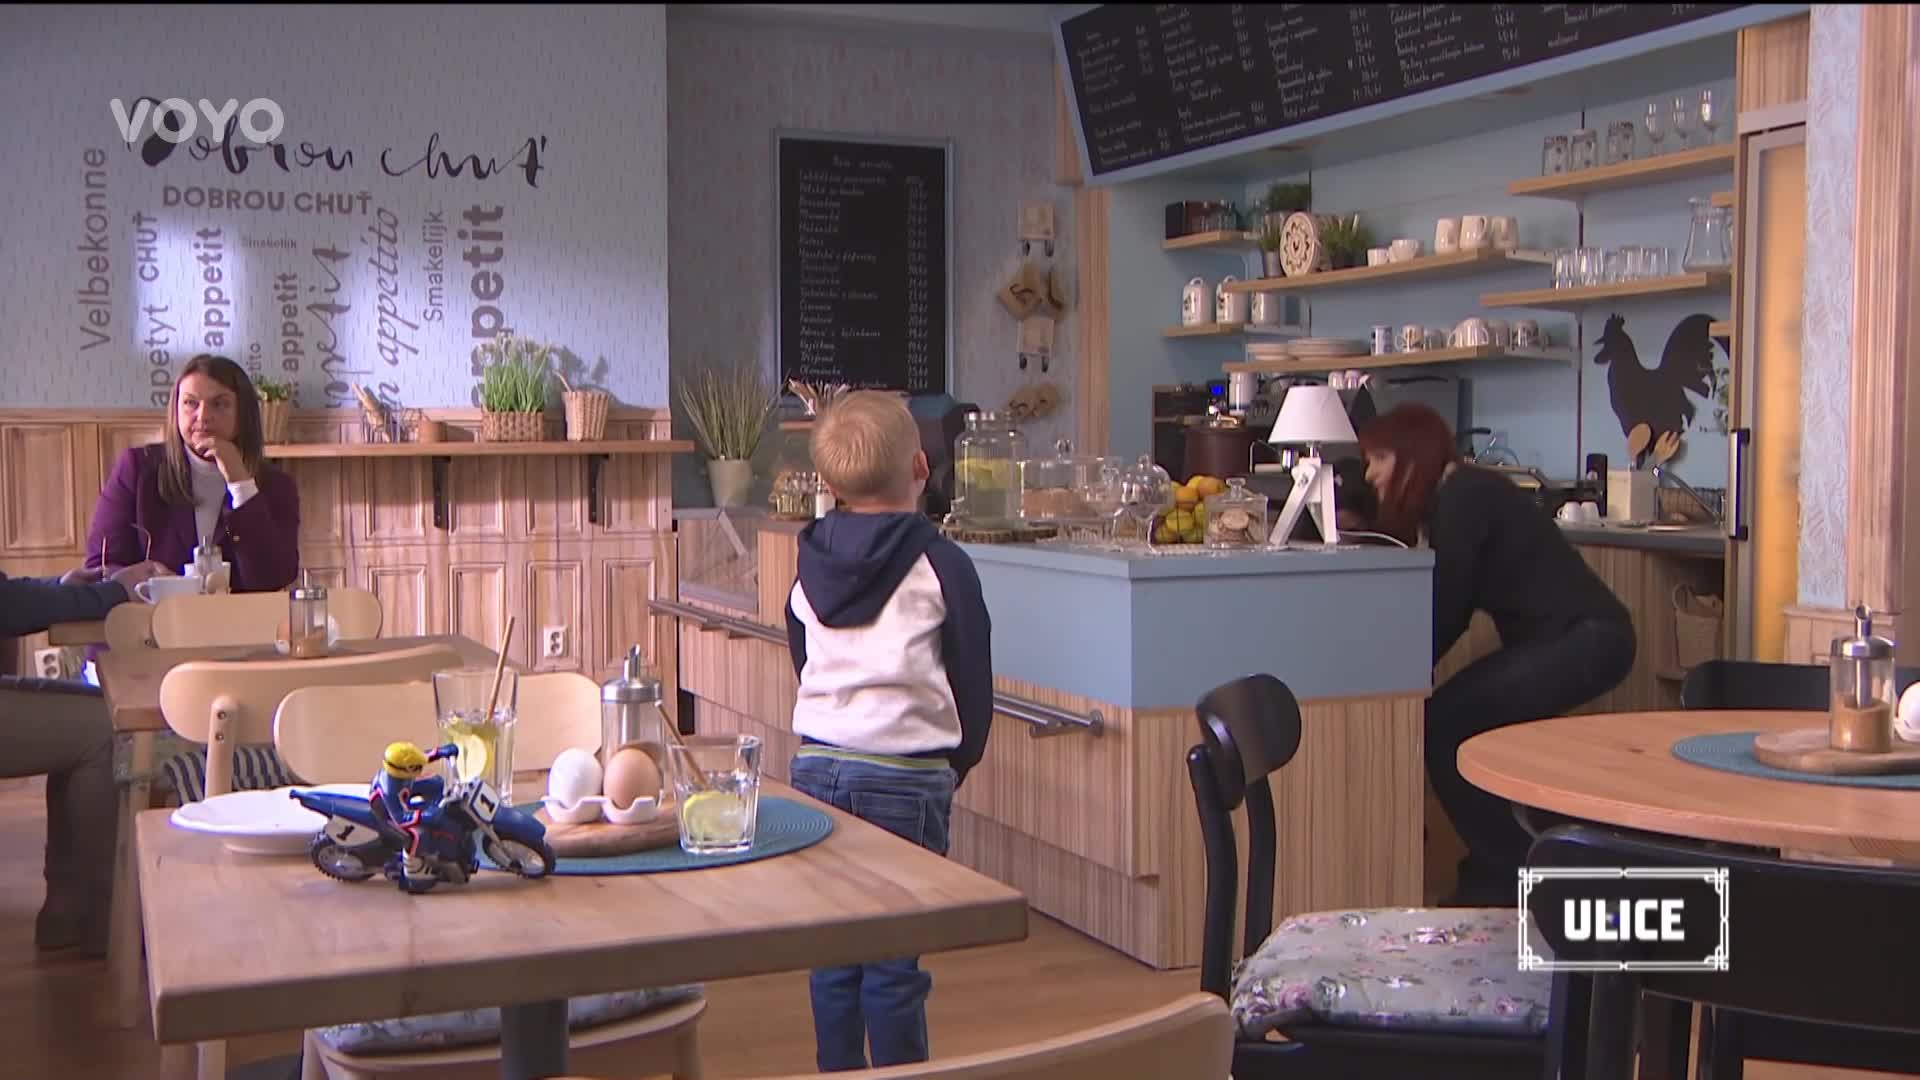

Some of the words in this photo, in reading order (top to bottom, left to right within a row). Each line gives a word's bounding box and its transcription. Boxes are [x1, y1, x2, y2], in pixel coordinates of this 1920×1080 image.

[78, 148, 111, 350] Velbekonne
[162, 185, 285, 212] DOBROU
[194, 226, 231, 348] appetit
[423, 210, 447, 321] Smakelijk
[274, 271, 304, 373] appetit
